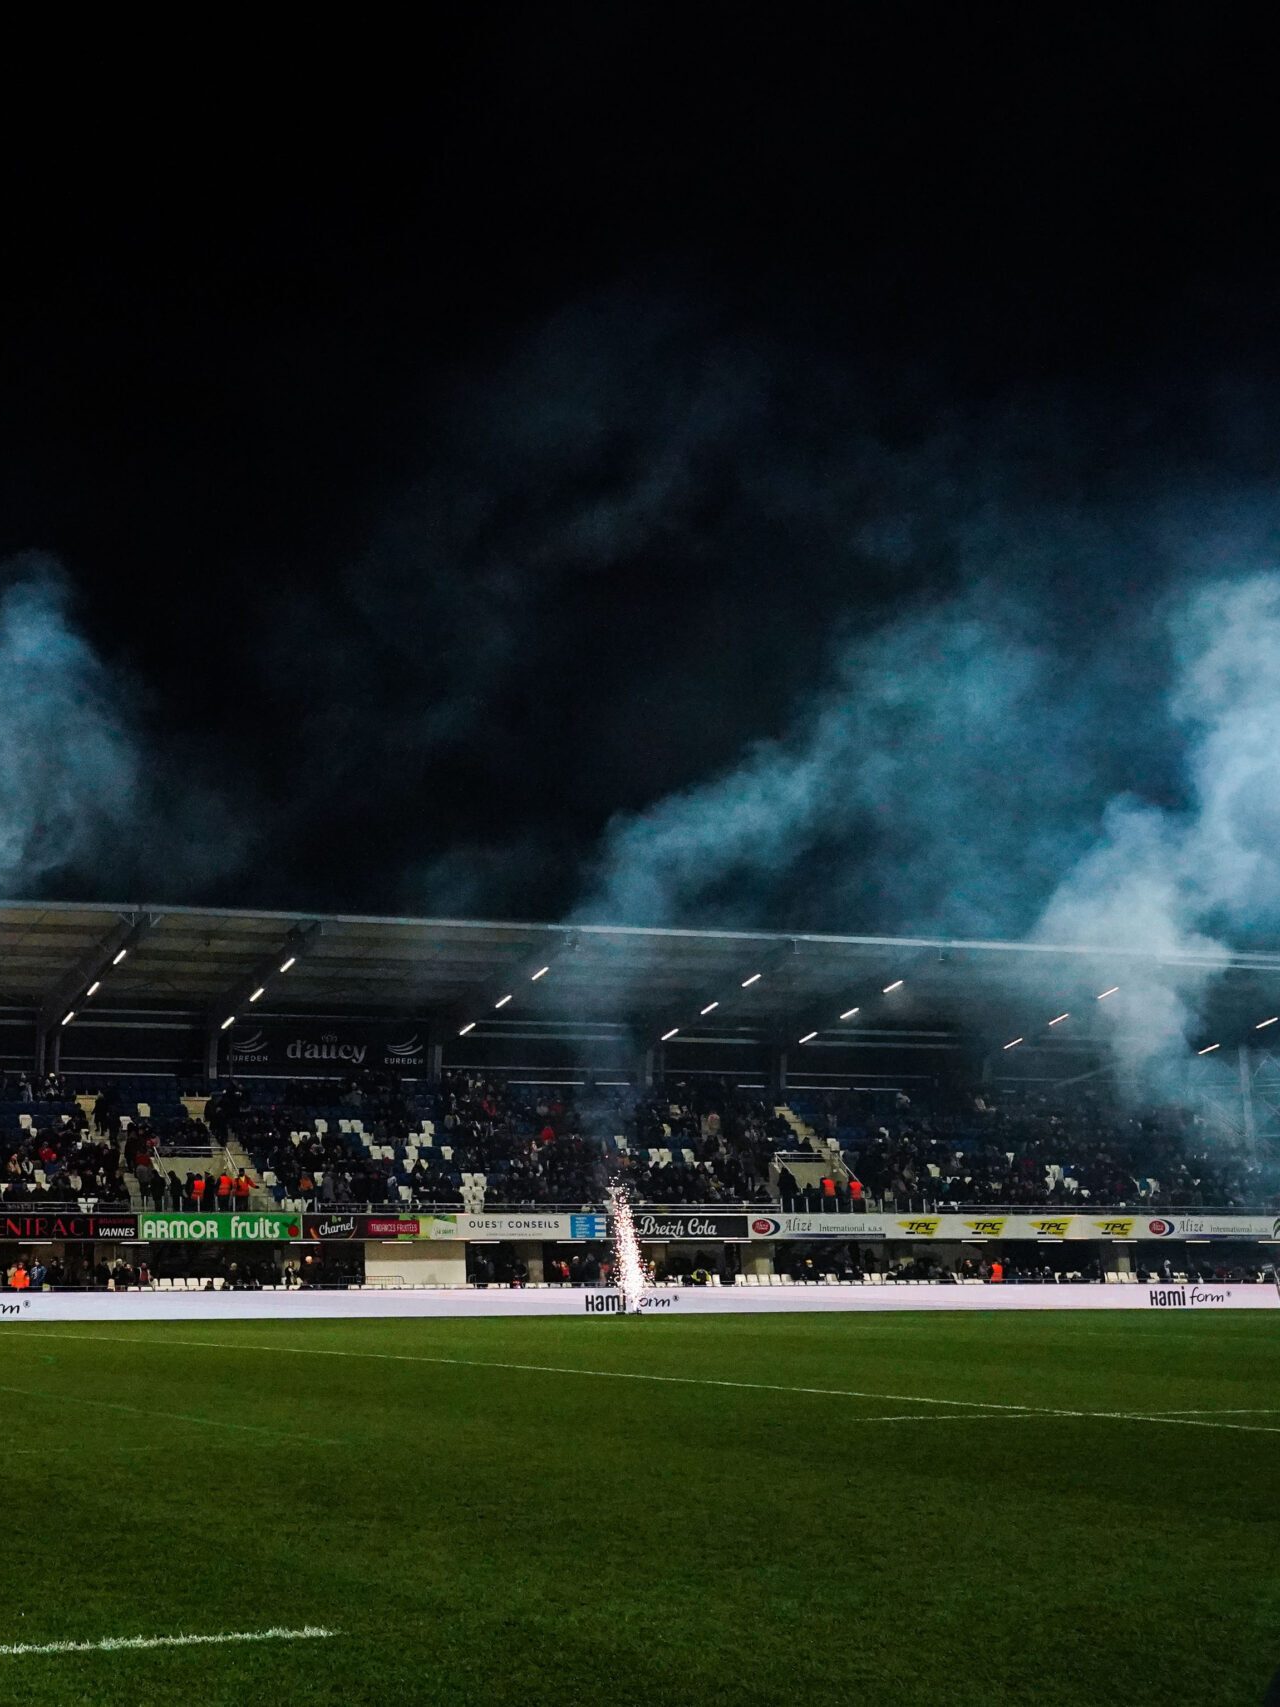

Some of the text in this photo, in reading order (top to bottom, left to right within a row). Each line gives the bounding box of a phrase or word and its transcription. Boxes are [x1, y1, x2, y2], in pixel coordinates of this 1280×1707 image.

[286, 1039, 367, 1064] d'aucy
[143, 1215, 280, 1239] ARMOR fruits
[318, 1216, 355, 1236] Charnel
[469, 1220, 560, 1229] OUEST CONSEILS
[638, 1215, 718, 1238] Breizh Cola
[819, 1223, 865, 1232] International
[908, 1222, 938, 1230] TPC
[974, 1222, 1003, 1230] TPC
[1039, 1222, 1068, 1231] TPC
[1104, 1223, 1132, 1231] TPC
[99, 1227, 136, 1237] VANNES
[1149, 1286, 1224, 1306] Hami form
